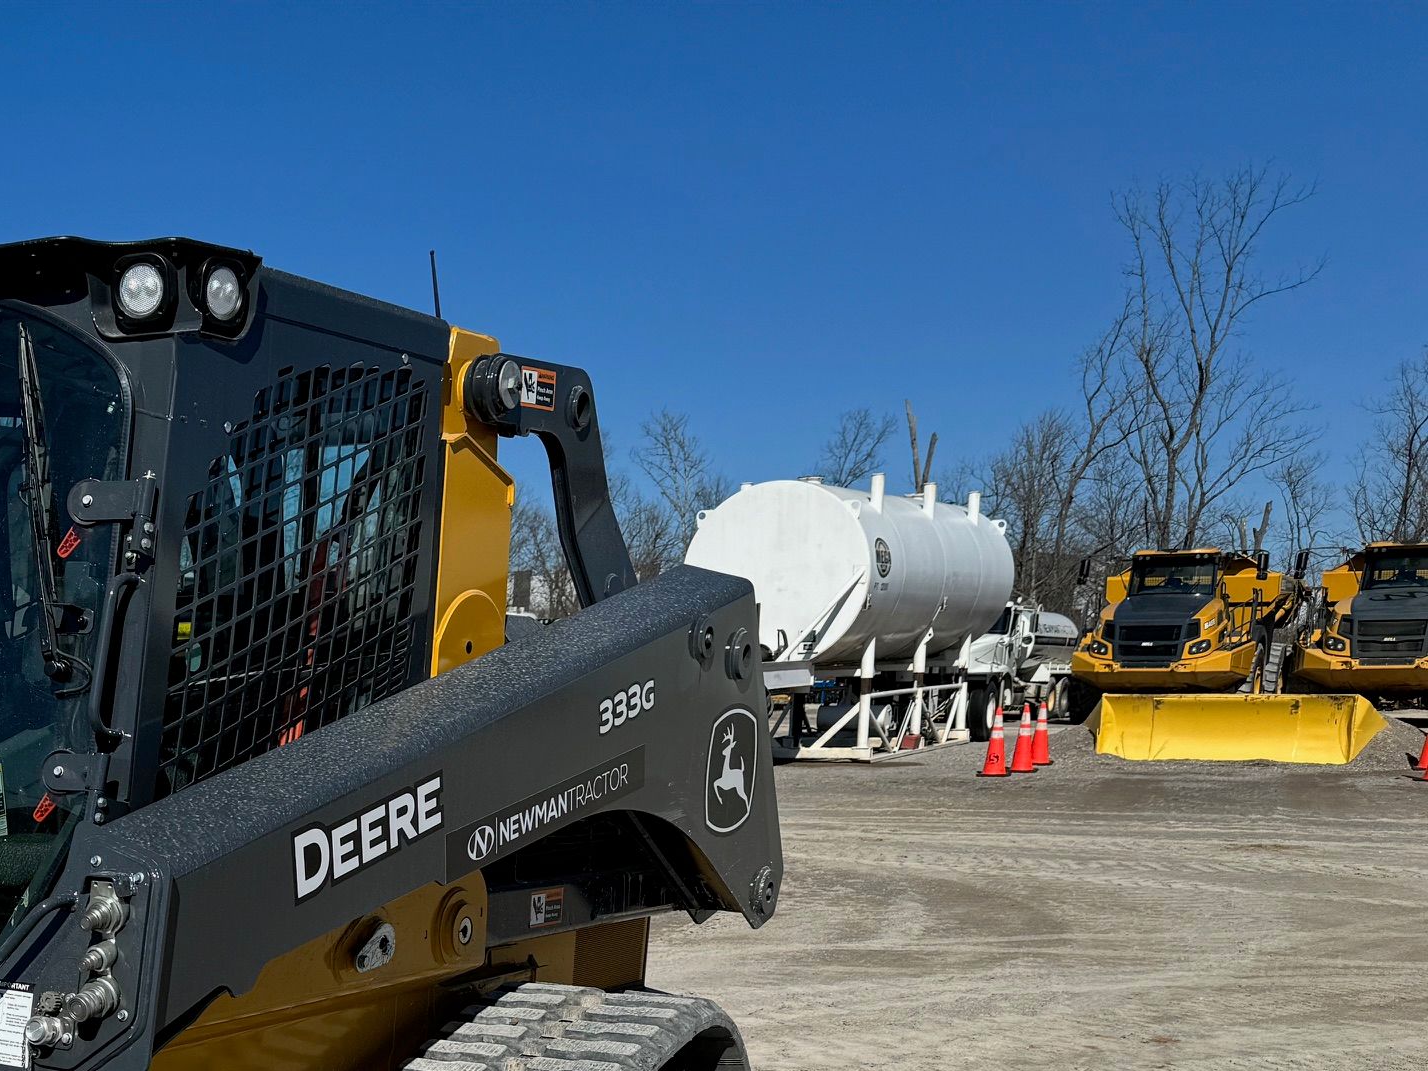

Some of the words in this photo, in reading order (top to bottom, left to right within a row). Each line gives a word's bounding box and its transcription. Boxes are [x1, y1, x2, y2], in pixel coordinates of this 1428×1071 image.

[598, 679, 656, 736] 333G
[294, 776, 442, 899] DEERE
[499, 763, 629, 847] NEWMANTRACTOR
